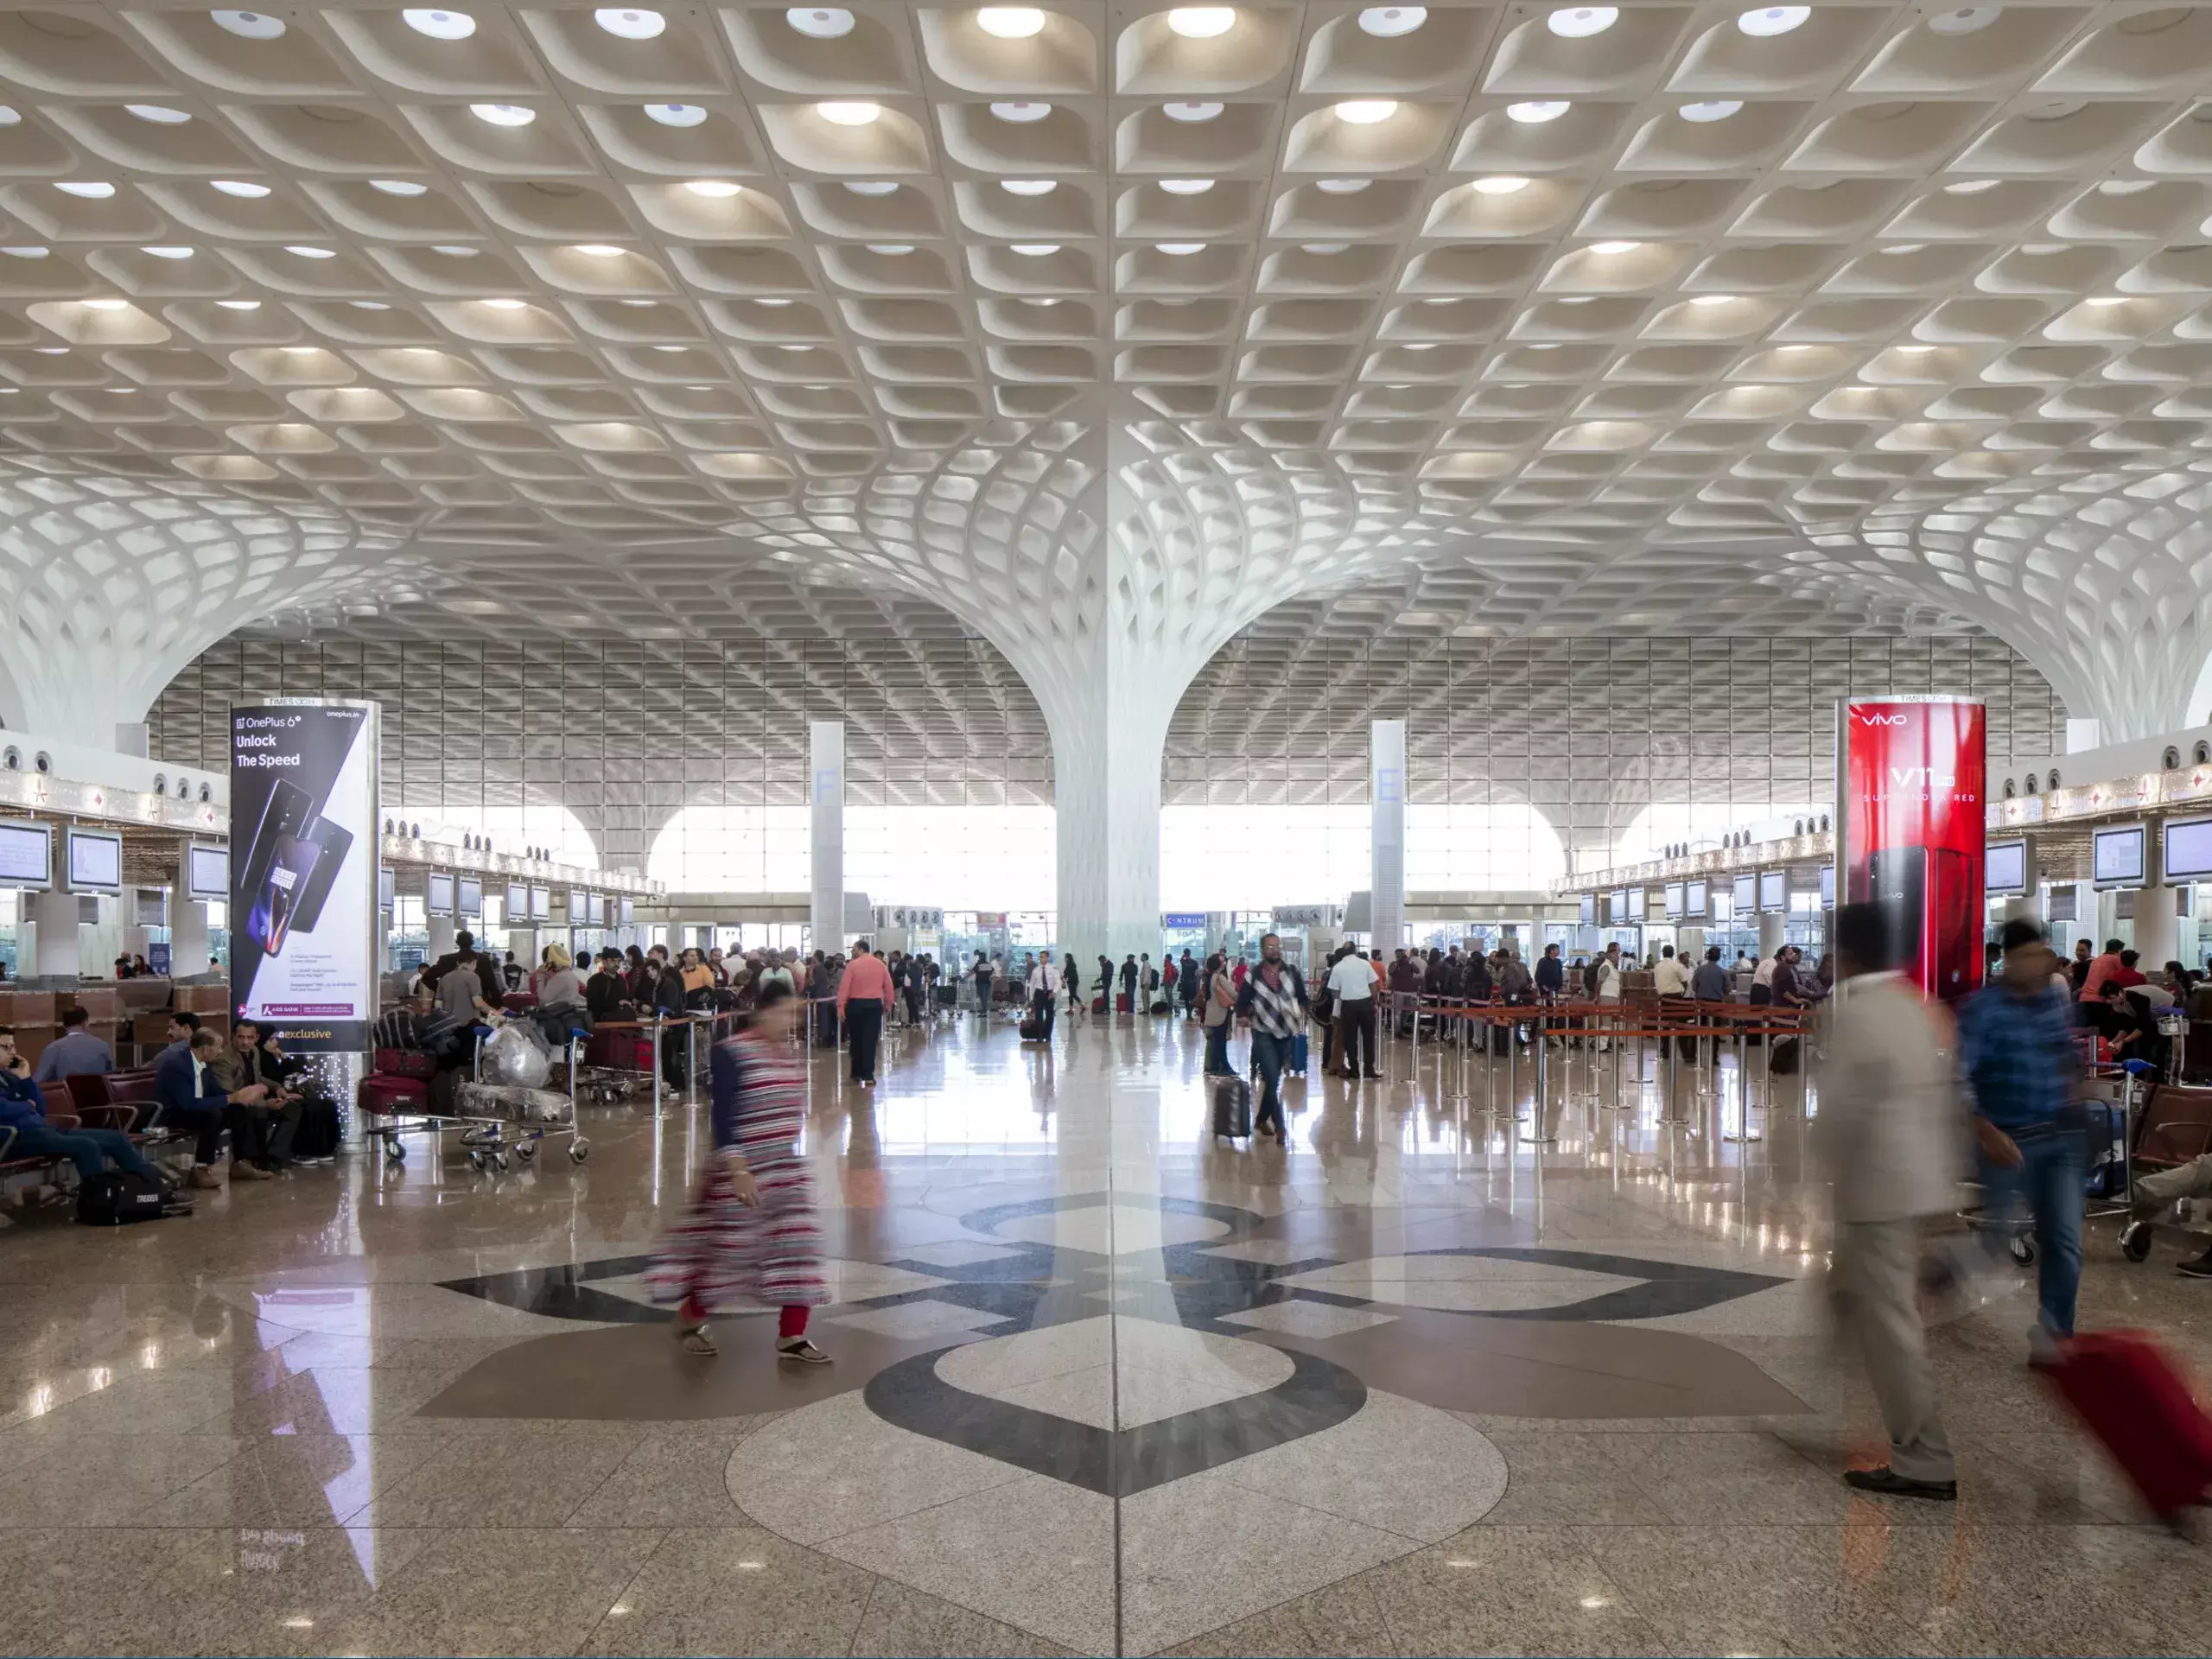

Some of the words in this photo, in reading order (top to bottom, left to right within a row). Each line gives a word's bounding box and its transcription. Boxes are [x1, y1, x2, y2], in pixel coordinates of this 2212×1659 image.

[245, 716, 286, 728] OnePlus
[1861, 713, 1908, 726] vivo
[236, 734, 276, 748] Unlock
[236, 754, 257, 767] The
[257, 753, 301, 769] Speed
[816, 770, 837, 804] F
[1378, 768, 1400, 801] E
[1954, 794, 1975, 803] RED
